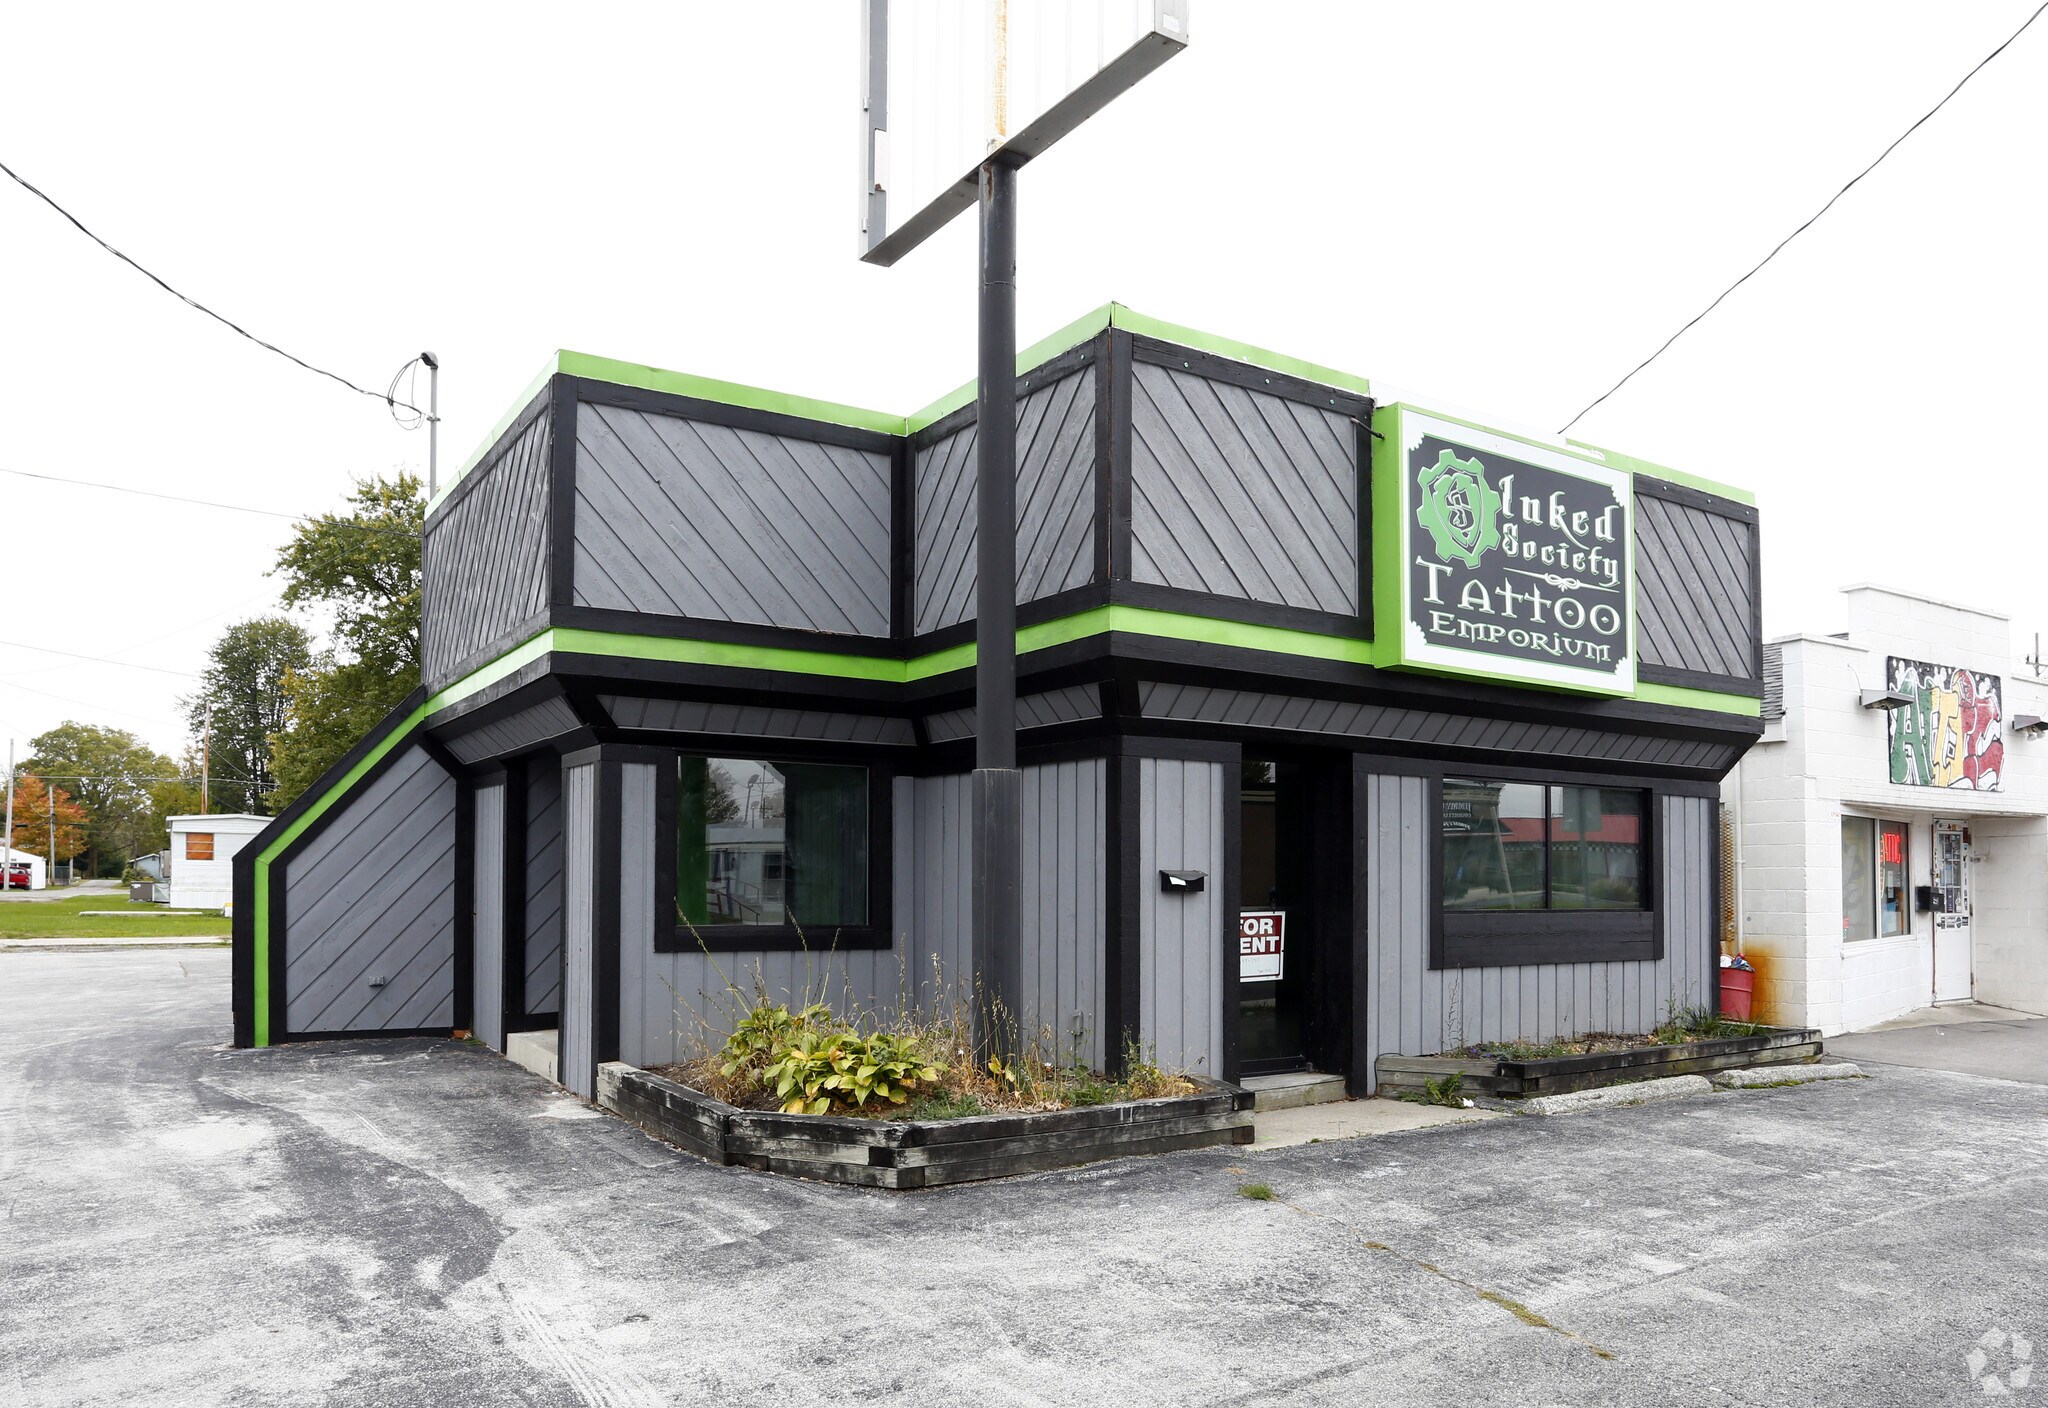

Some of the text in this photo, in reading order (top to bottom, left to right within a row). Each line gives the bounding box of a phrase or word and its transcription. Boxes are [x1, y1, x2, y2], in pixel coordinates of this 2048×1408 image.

[1499, 474, 1620, 547] Inked
[1502, 523, 1620, 588] Society
[1240, 936, 1280, 954] ENT
